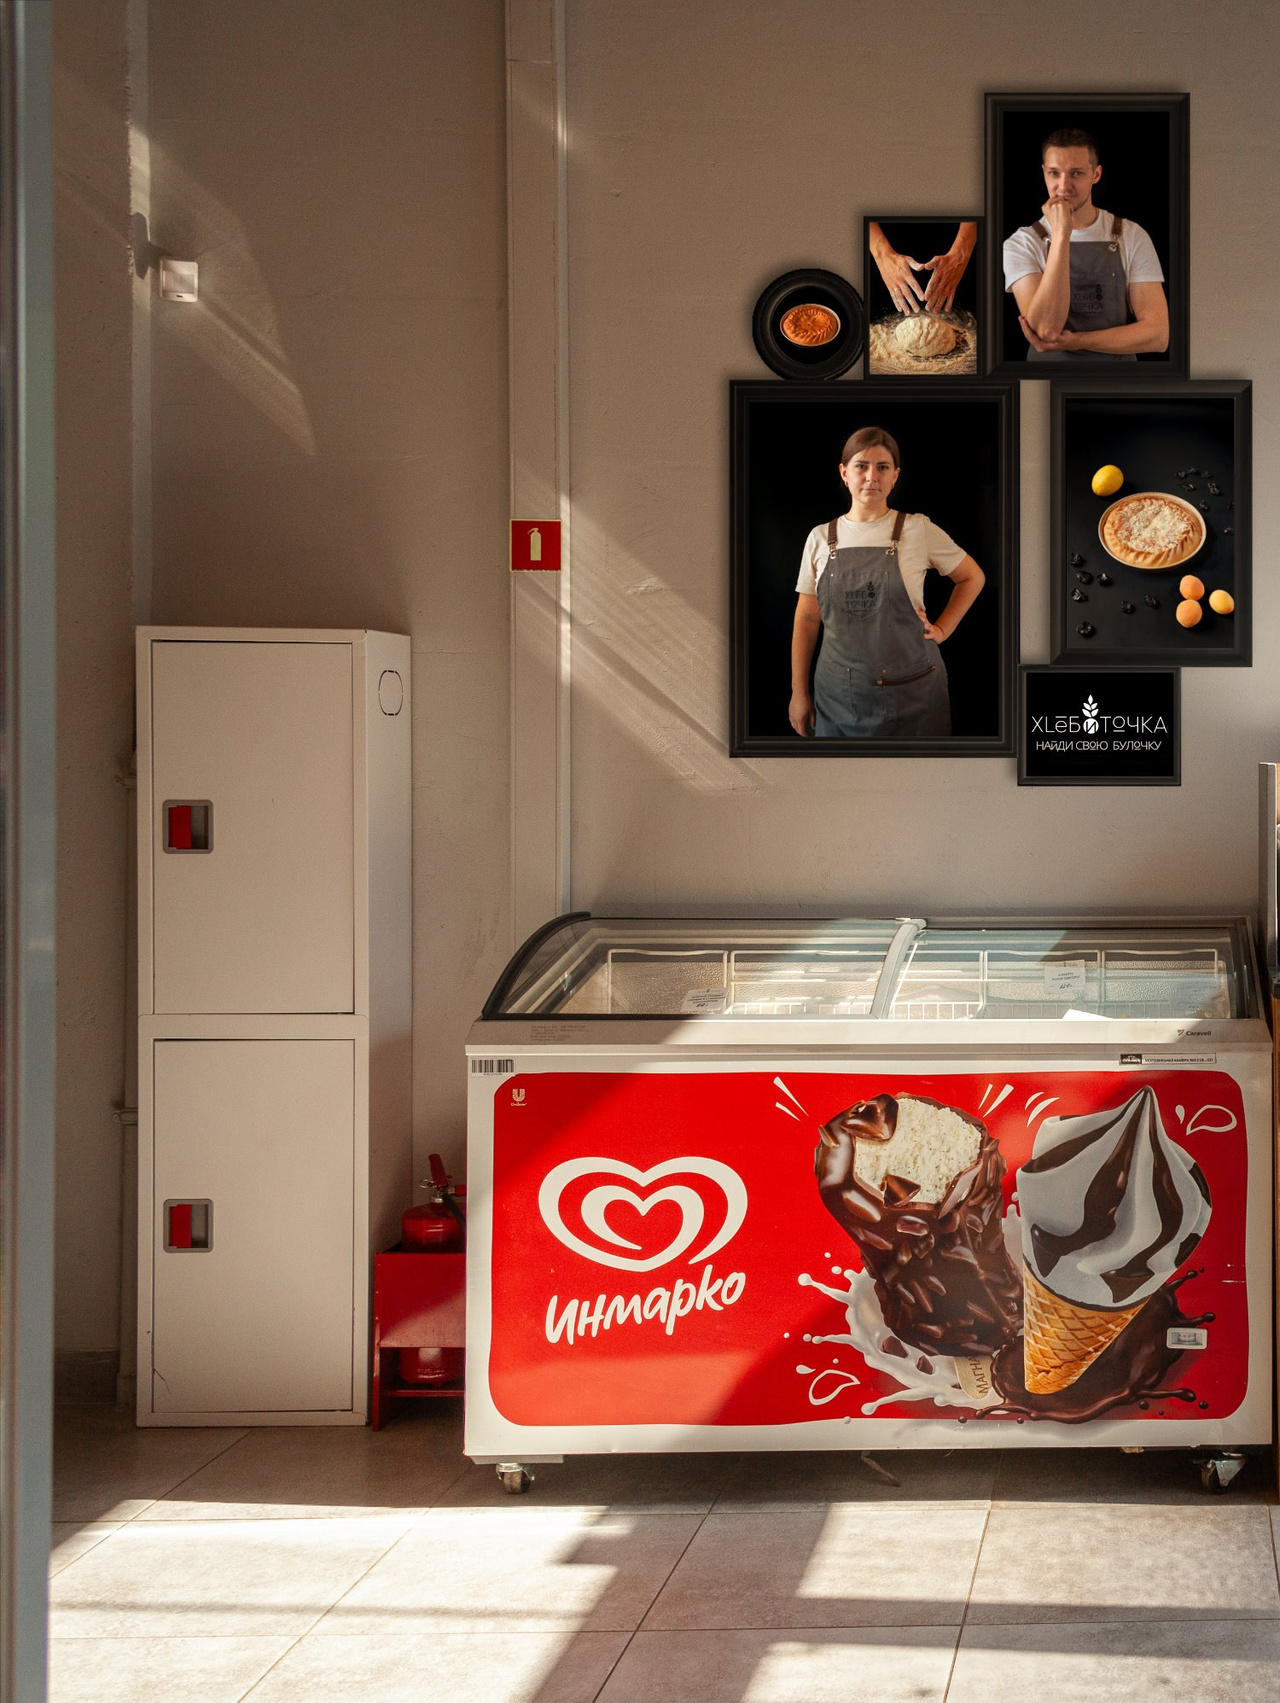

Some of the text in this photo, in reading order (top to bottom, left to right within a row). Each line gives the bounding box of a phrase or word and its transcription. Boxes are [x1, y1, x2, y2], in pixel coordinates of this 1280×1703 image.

[1036, 740, 1163, 752] НАЙДИ СВОЮ БУЛОЧКУ
[545, 1264, 746, 1345] Инмарко
